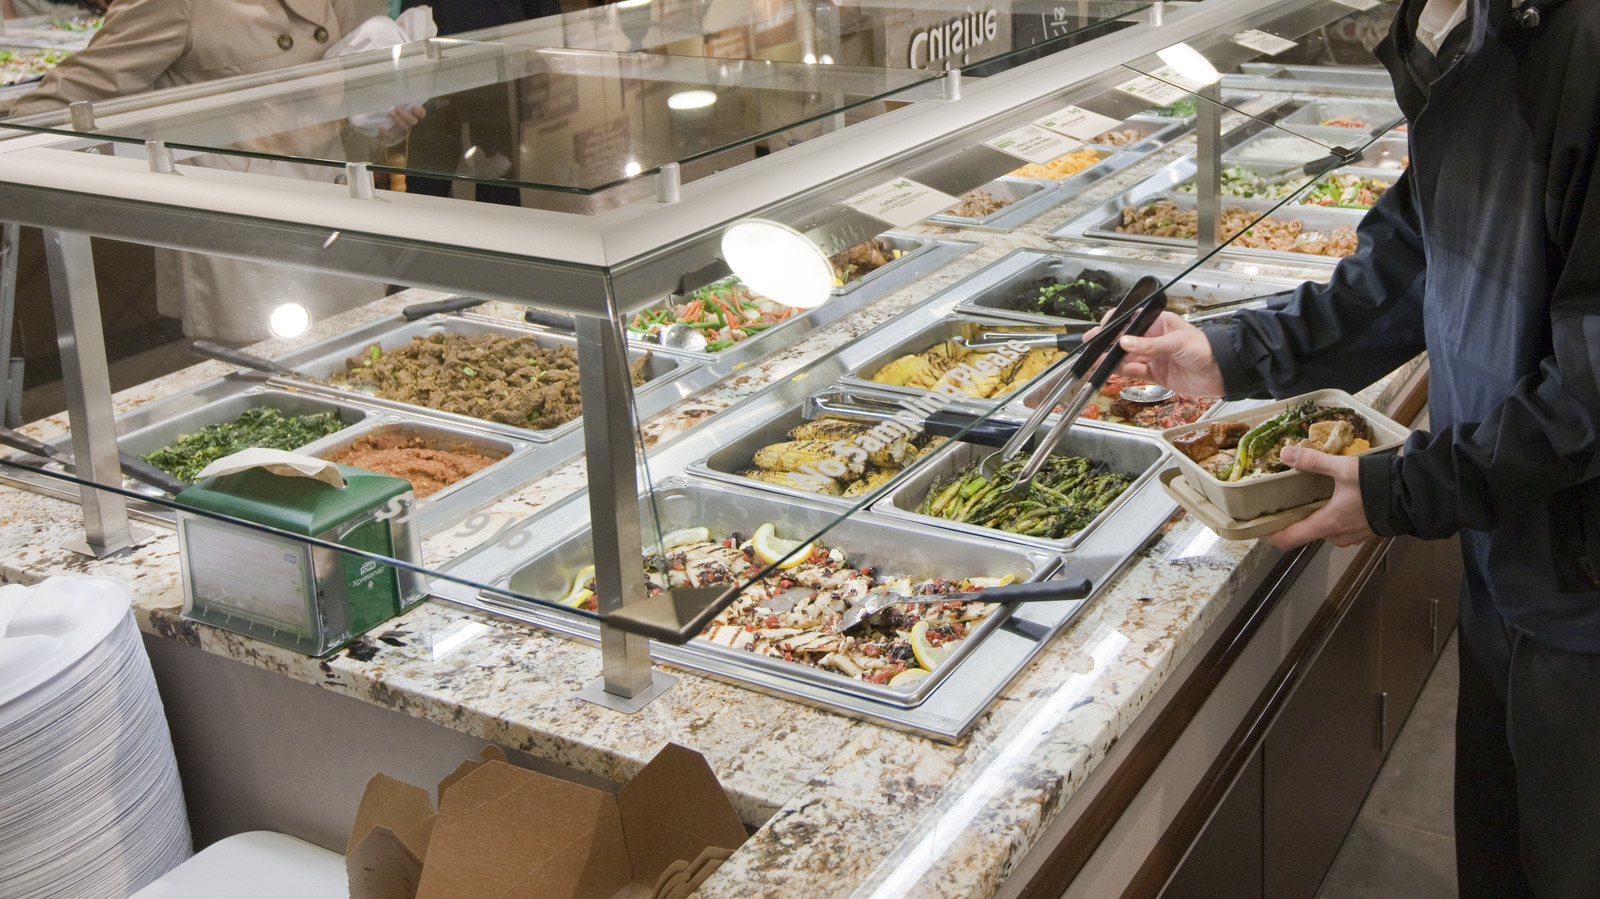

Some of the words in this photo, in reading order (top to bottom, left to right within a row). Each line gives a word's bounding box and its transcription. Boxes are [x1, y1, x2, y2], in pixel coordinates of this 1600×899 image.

[786, 460, 846, 494] No
[833, 383, 970, 463] Sampling
[950, 339, 1031, 388] Please
